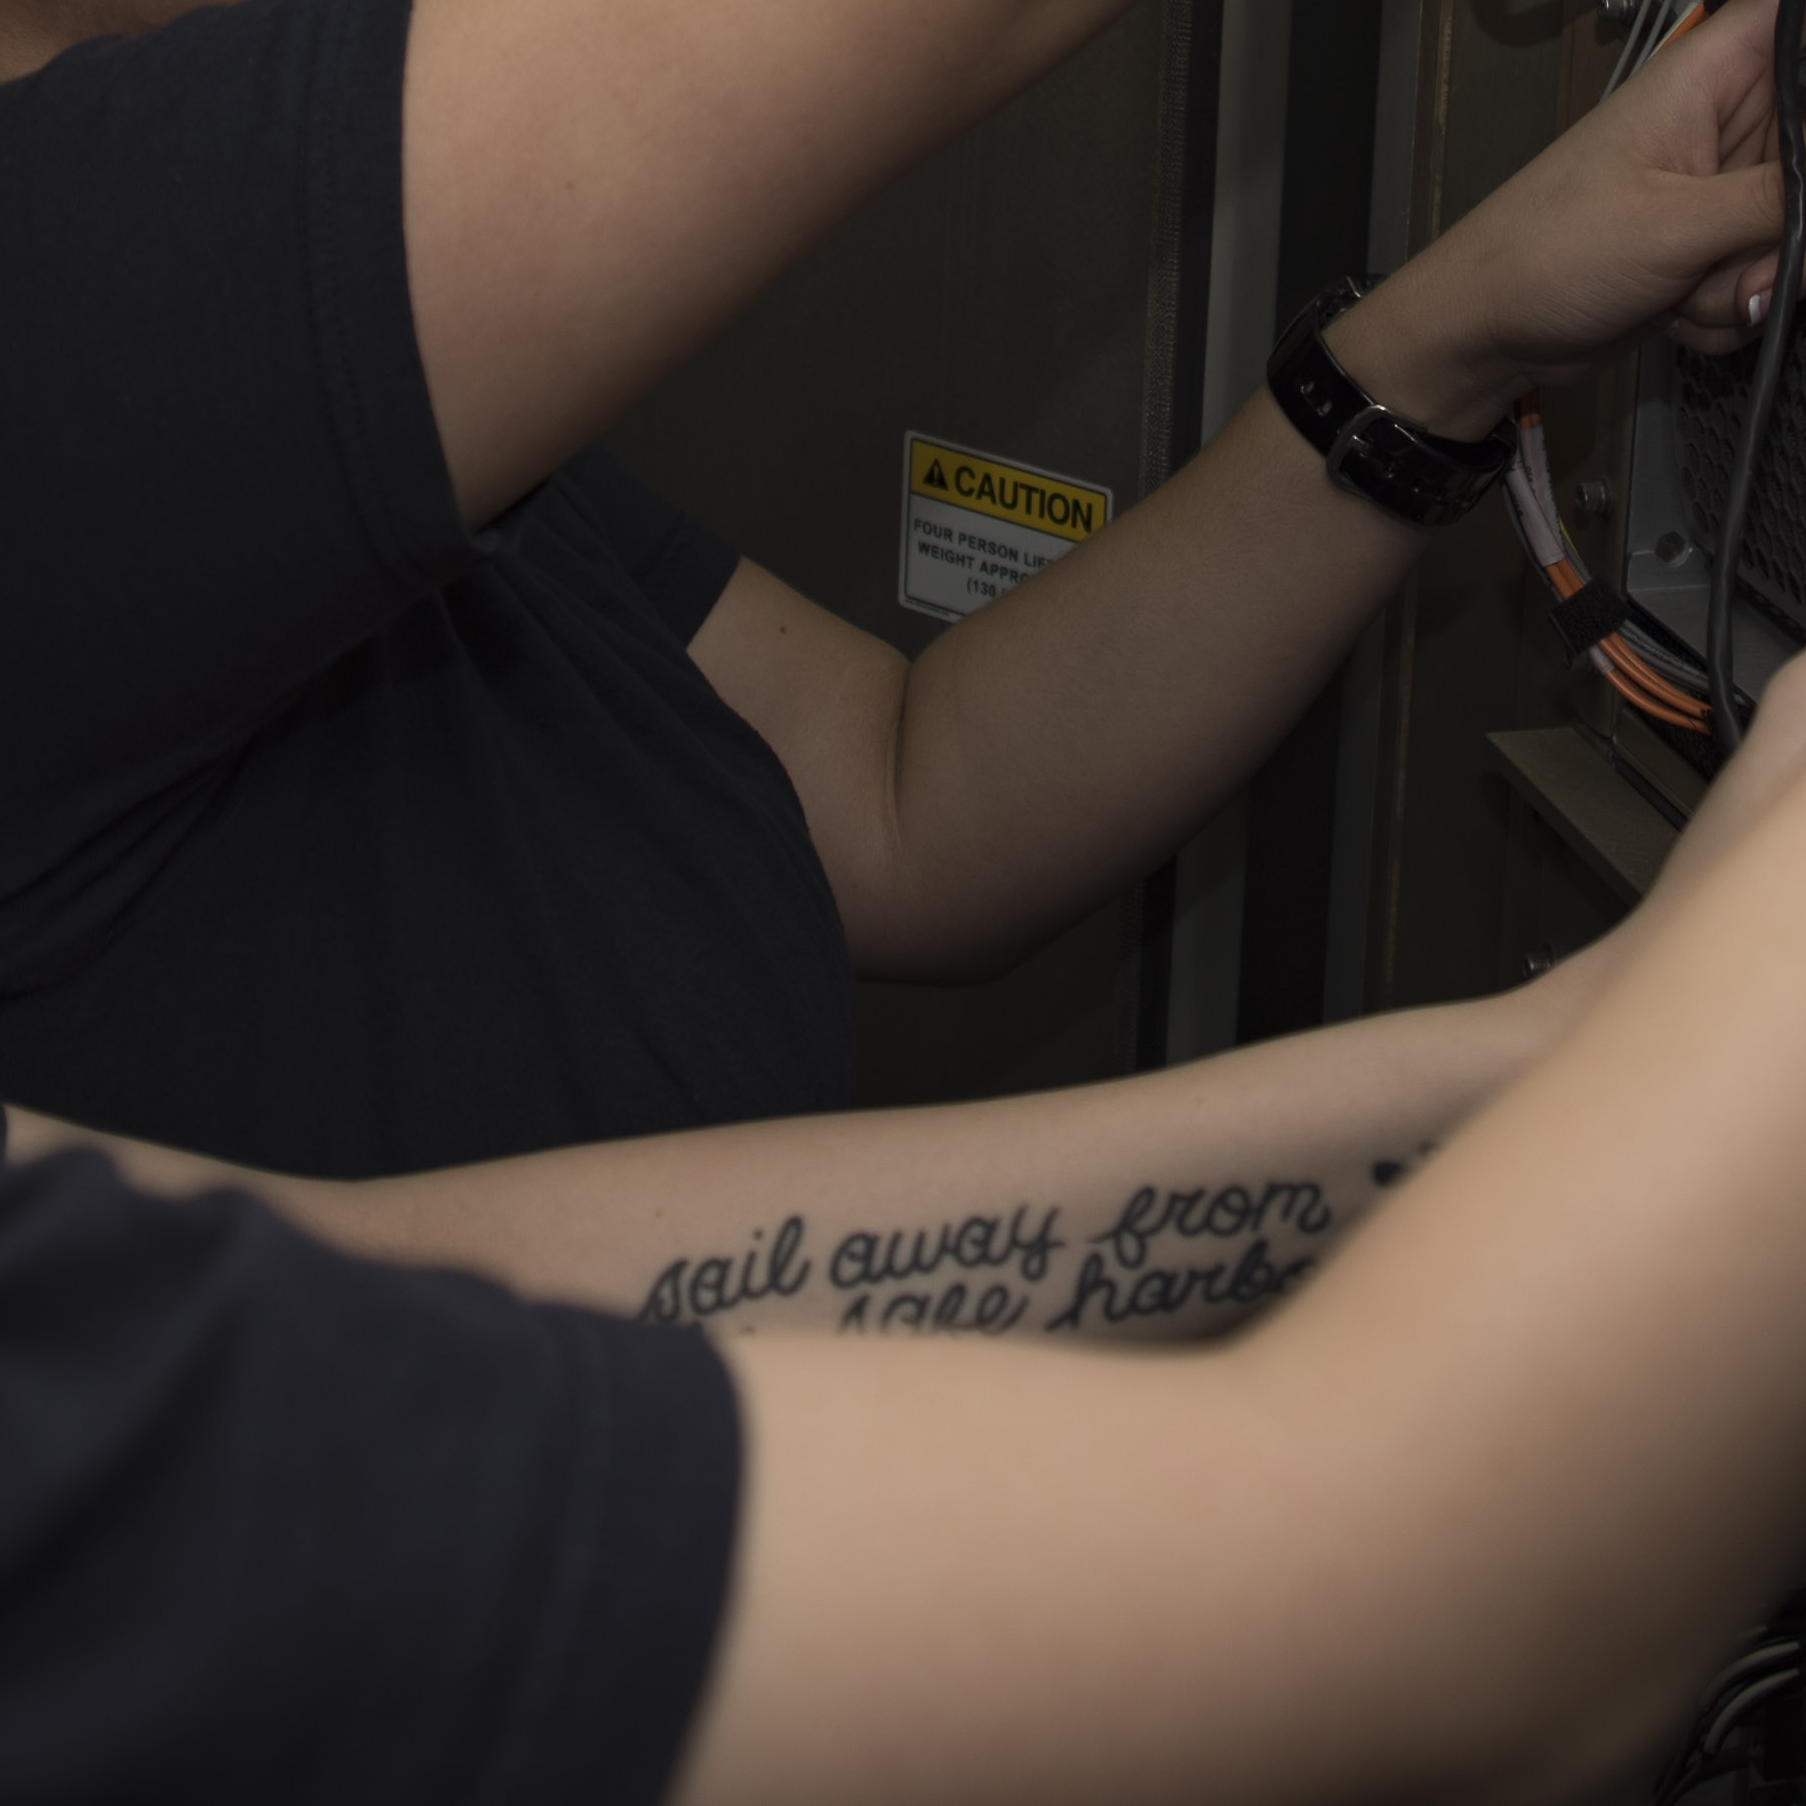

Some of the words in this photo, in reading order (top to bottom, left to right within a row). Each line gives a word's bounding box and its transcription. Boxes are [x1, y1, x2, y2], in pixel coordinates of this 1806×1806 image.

[954, 465, 1093, 534] CAUTION
[913, 518, 953, 543] FOUR
[958, 532, 1018, 562] PERSON
[917, 540, 975, 570] WEIGHT
[979, 560, 1031, 584] APPRO
[639, 1214, 811, 1323] sail
[829, 1205, 1063, 1289] away
[1089, 1181, 1331, 1269] from
